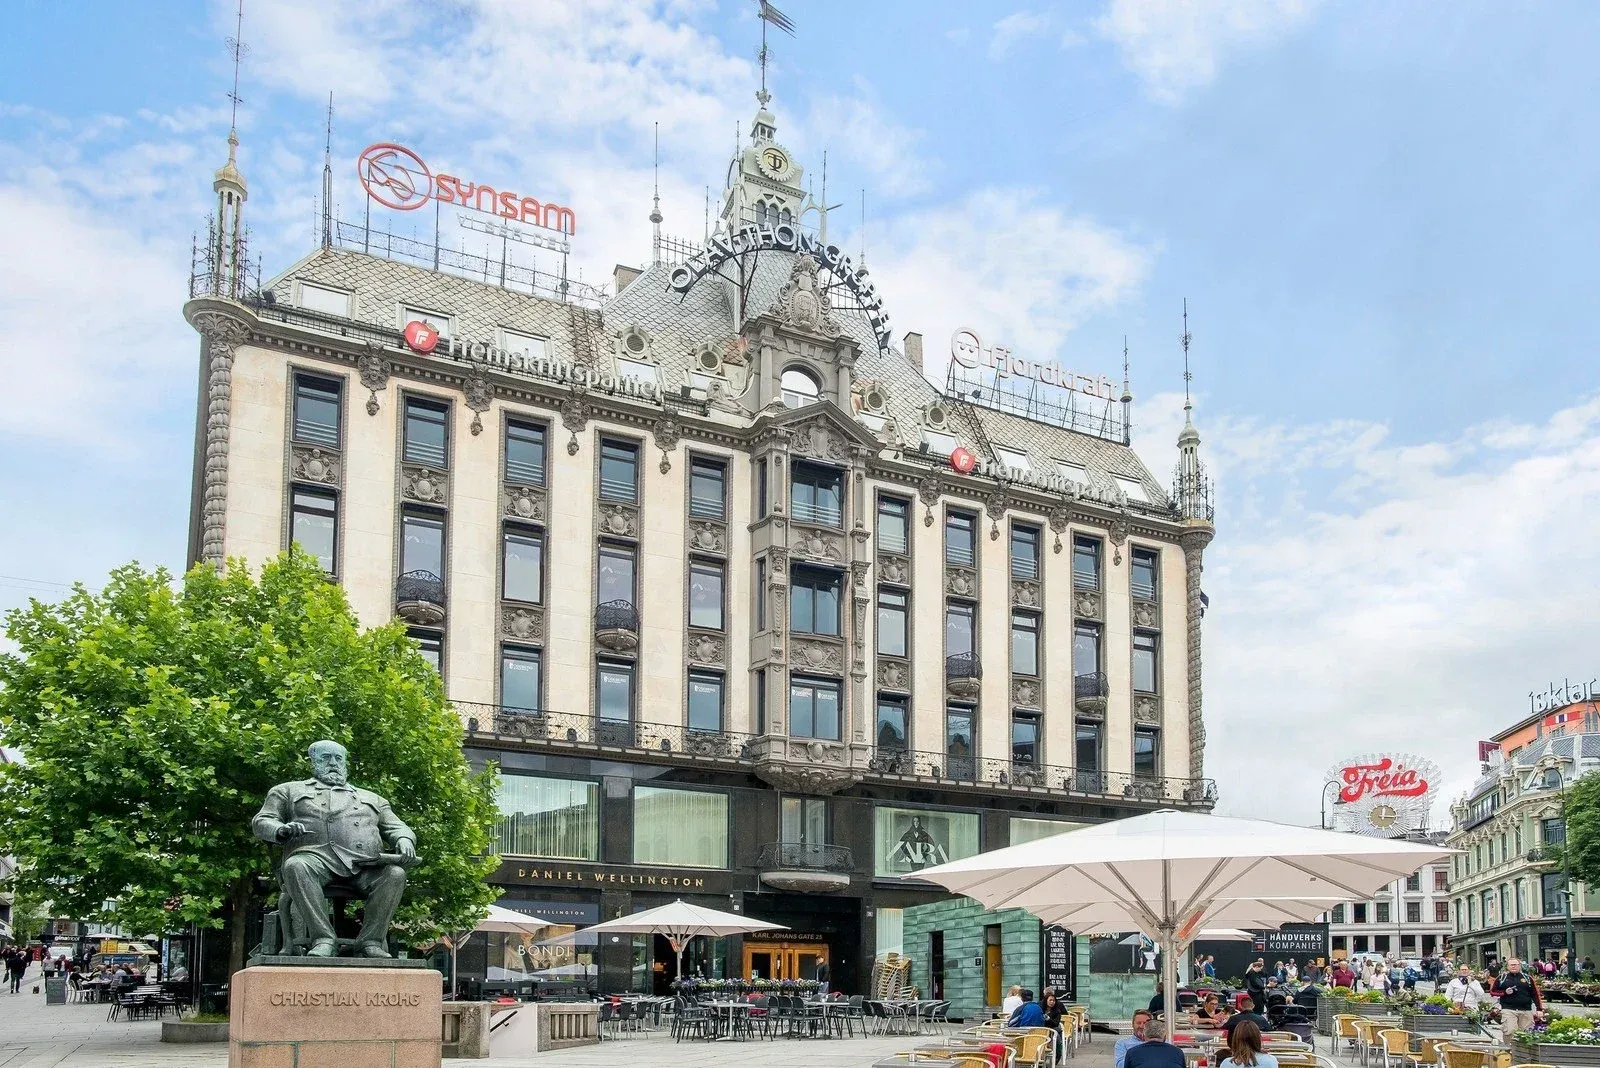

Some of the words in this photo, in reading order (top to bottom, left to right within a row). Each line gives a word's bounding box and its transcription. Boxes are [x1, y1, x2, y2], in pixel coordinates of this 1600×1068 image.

[435, 173, 576, 236] SYNSAM
[669, 229, 736, 293] OLAV
[741, 221, 822, 255] THON
[1339, 758, 1428, 802] Freia
[886, 840, 949, 864] ZARA
[518, 868, 583, 882] DANIEL
[594, 873, 704, 887] WELLINGTON
[1269, 932, 1322, 941] HÅNDVERKS
[1269, 941, 1323, 950] KOMPANIET
[517, 944, 570, 957] BONDI
[270, 991, 359, 1007] CHRISTIAN
[365, 993, 420, 1007] KROHG
